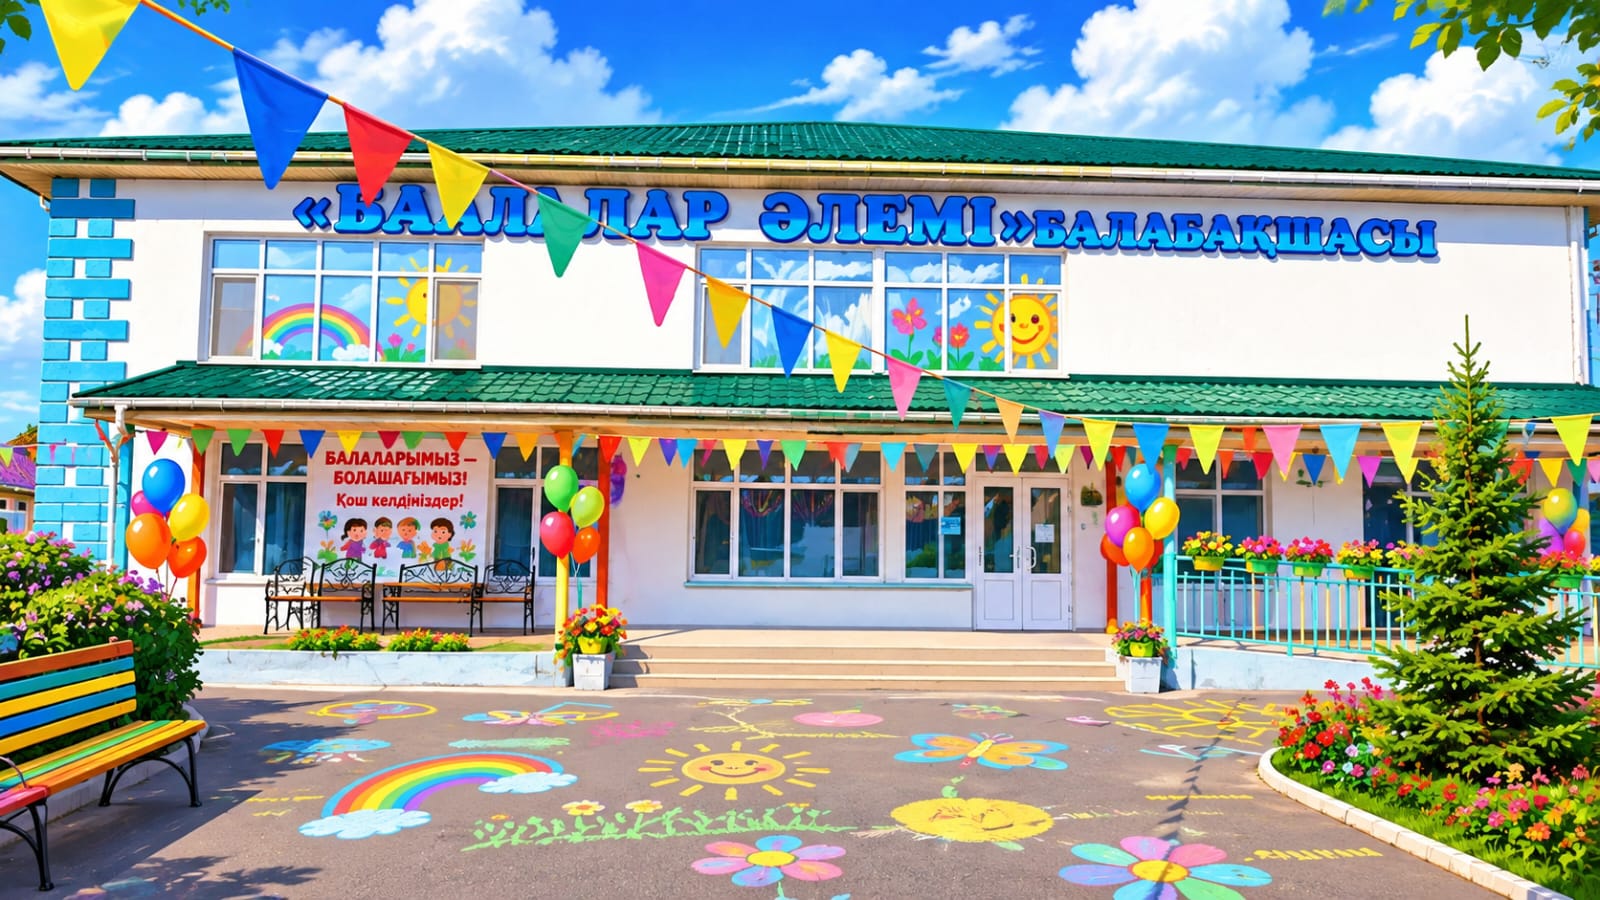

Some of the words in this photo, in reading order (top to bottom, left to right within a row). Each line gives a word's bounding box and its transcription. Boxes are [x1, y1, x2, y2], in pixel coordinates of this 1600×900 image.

[1032, 209, 1439, 260] БАЛАБАҚШАСЫ
[325, 450, 460, 466] БАЛАЛАРЫМЫЗ
[333, 470, 468, 486] БОЛАШАҒЫМЫЗ!
[336, 492, 368, 508] Қош
